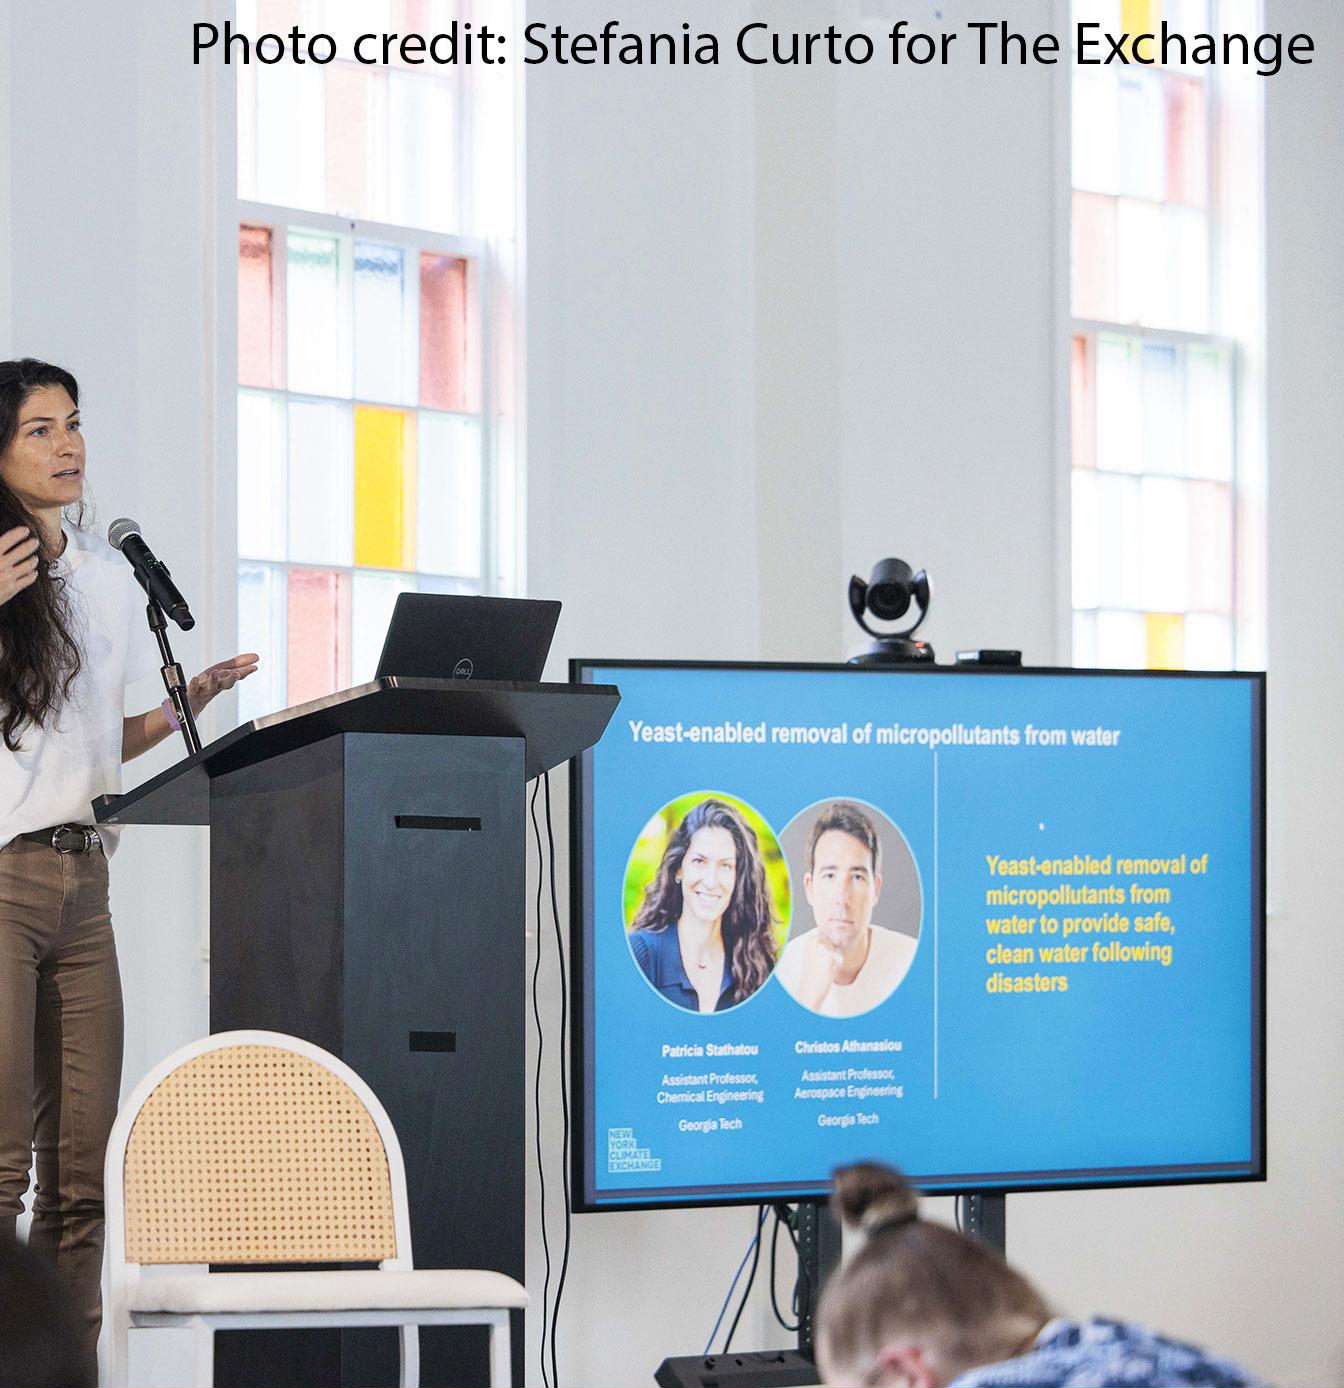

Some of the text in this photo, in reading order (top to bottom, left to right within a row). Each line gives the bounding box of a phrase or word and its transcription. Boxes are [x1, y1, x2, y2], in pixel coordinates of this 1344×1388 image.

[628, 720, 1121, 750] Yeast-enabled removal of micropollutants from water
[985, 853, 1208, 876] Yeast-enabled removal of
[986, 884, 1171, 909] micropollutants from
[985, 911, 1175, 938] water to provide safe,
[986, 941, 1173, 966] clean water following
[986, 972, 1068, 993] disasters
[662, 1043, 759, 1057] Patricia Stathatou
[795, 1039, 902, 1054] Christos Athanasiou
[661, 1072, 758, 1086] Assistant Professor,
[801, 1068, 895, 1081] Assistant Professor,
[657, 1089, 765, 1104] Chemical Engineering
[794, 1084, 904, 1100] Aerospace Engineering
[678, 1117, 743, 1133] Georgia Tech
[817, 1112, 879, 1128] Georgia Tech
[610, 1130, 630, 1138] NEW
[610, 1160, 660, 1171] EXCHANGE
